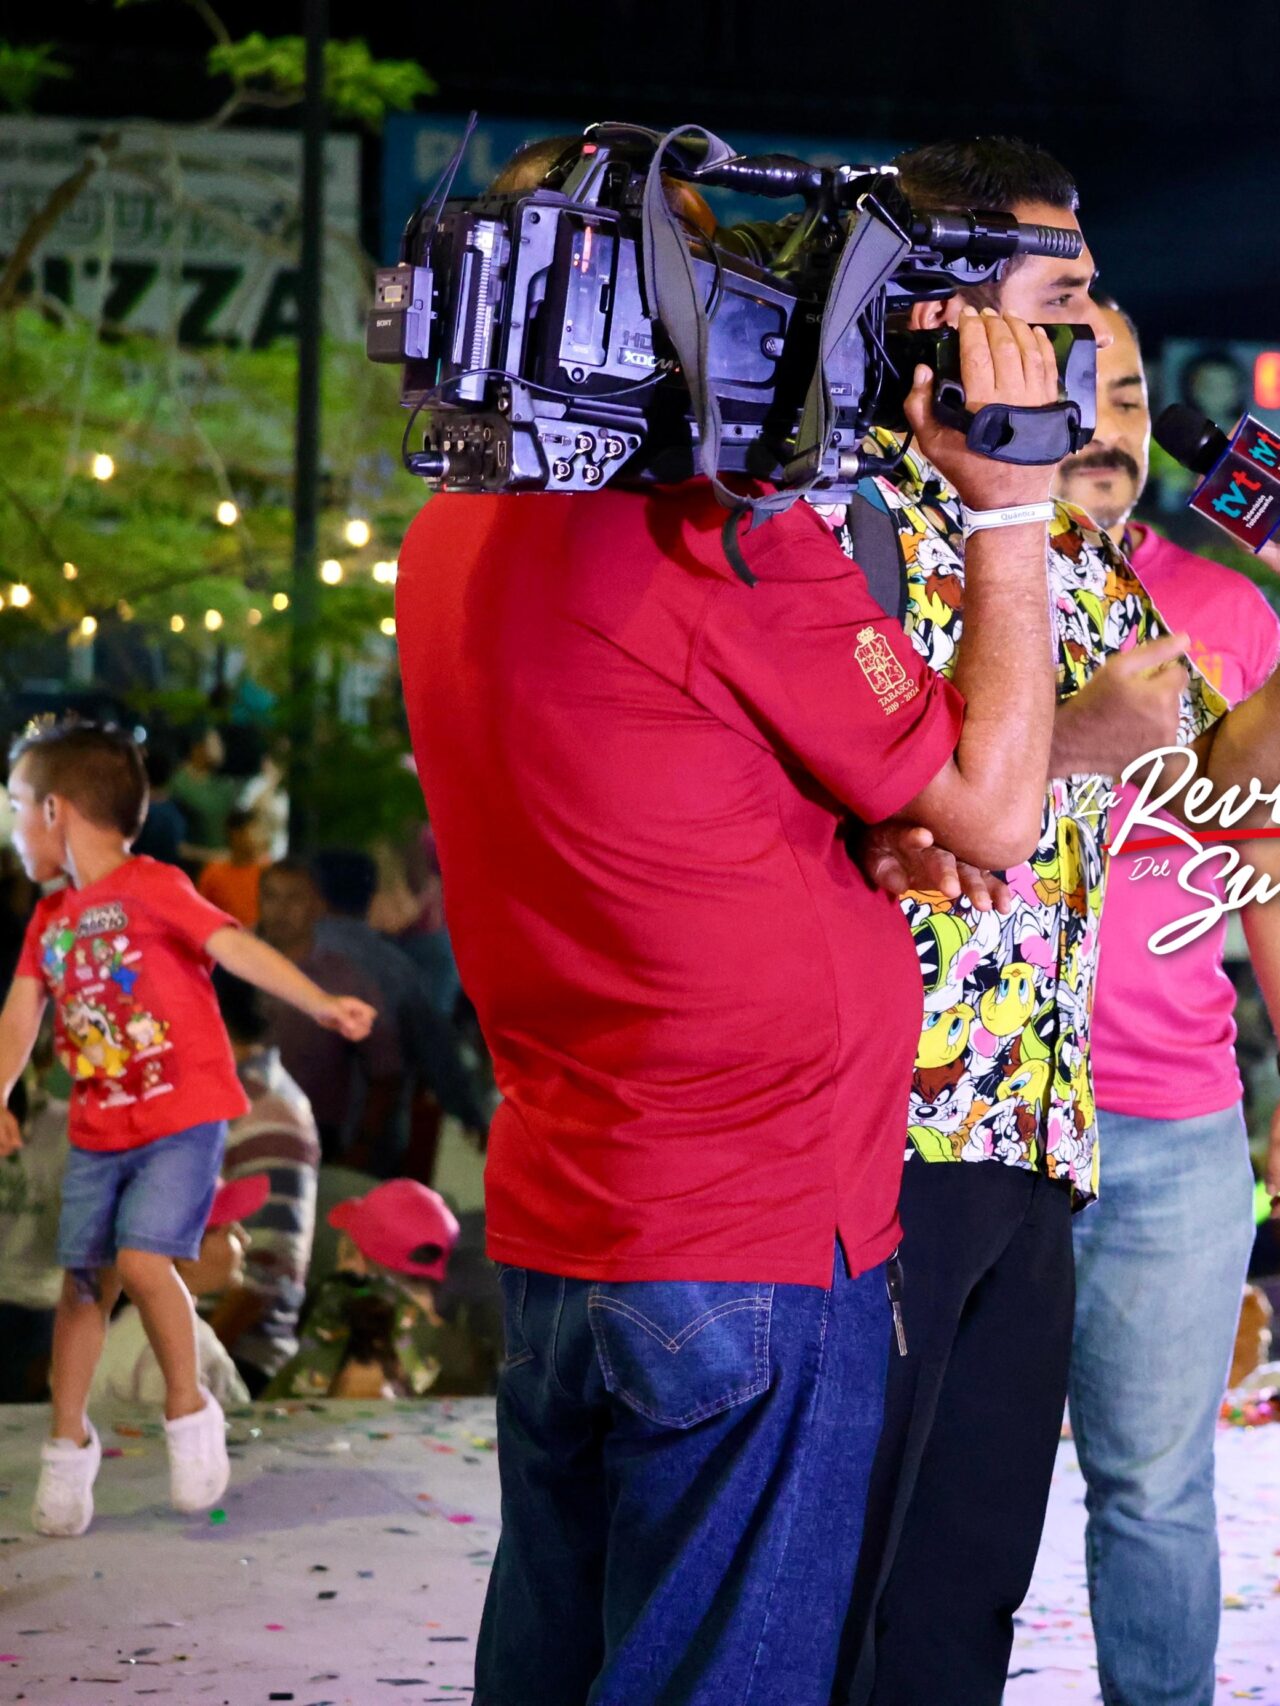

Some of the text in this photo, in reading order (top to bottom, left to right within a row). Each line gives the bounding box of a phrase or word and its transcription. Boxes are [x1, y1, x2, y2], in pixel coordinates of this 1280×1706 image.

[1211, 470, 1262, 518] tvt
[1000, 510, 1036, 521] Quántica
[877, 678, 914, 707] TABASCO
